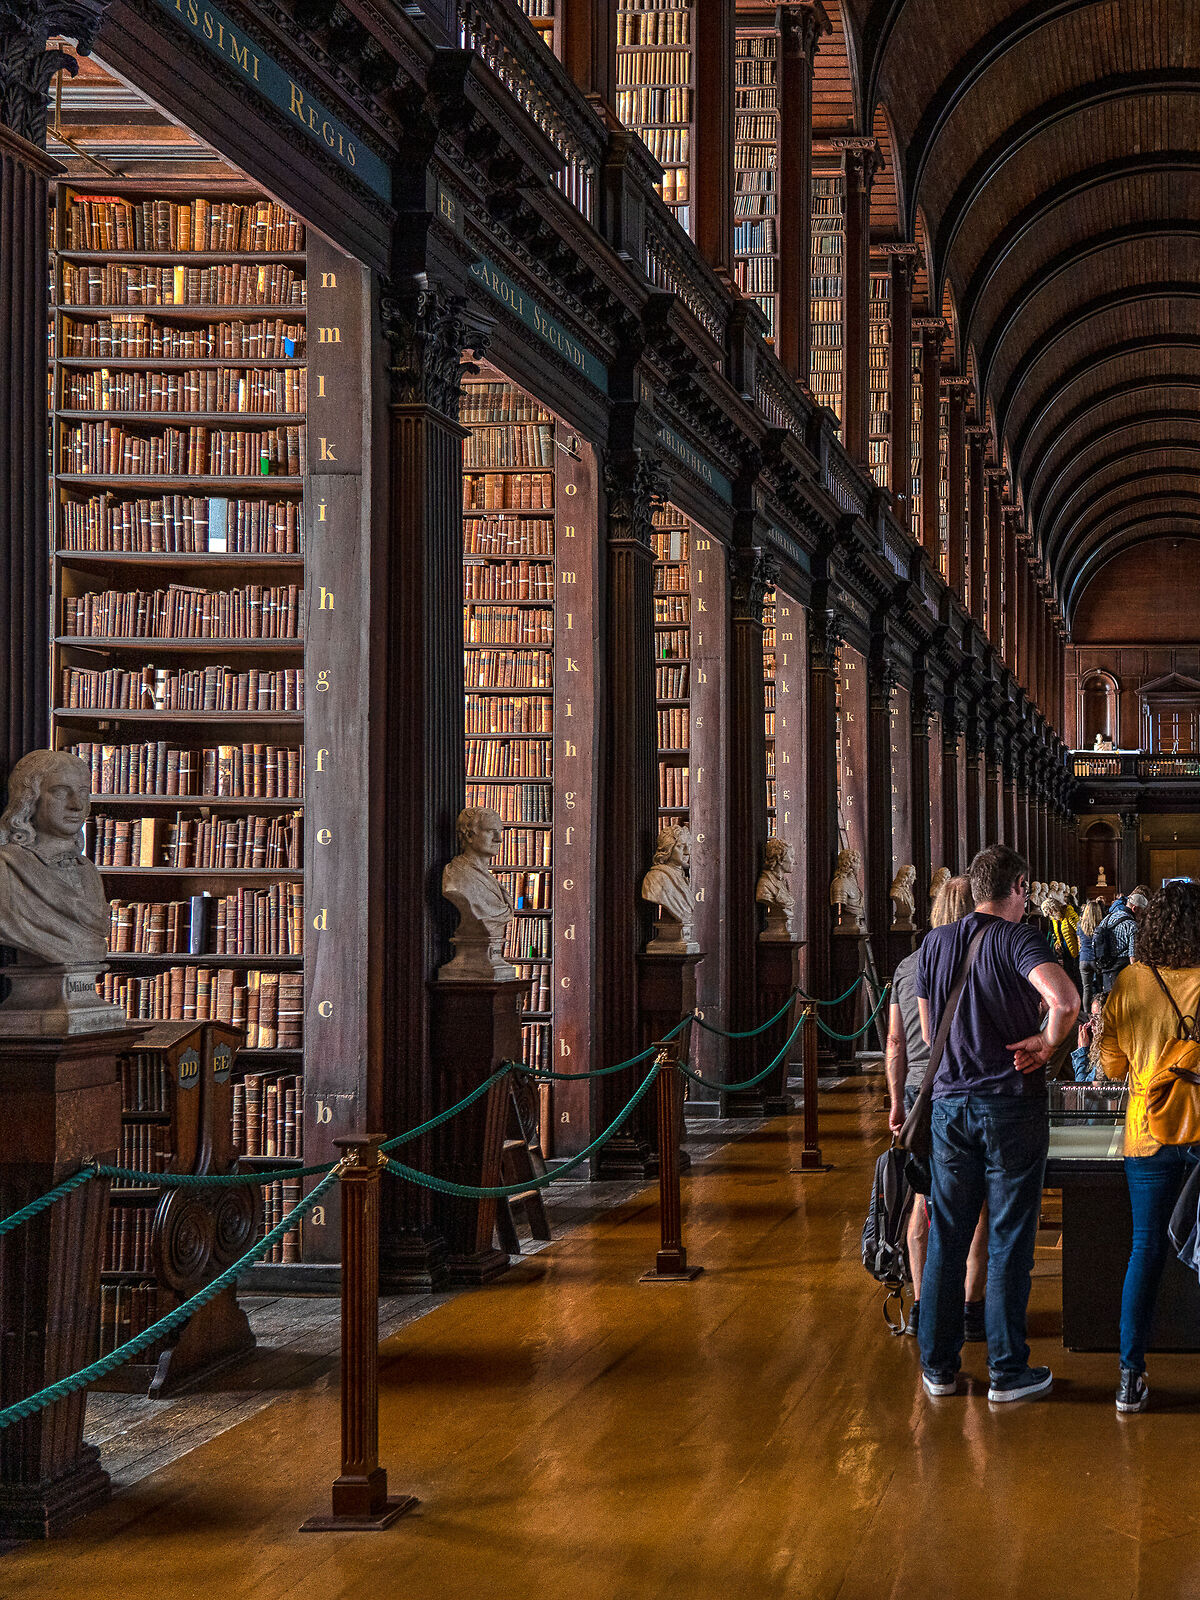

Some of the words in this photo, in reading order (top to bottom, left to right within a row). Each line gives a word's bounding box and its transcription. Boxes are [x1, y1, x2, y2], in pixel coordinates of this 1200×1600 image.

[289, 80, 355, 166] REGIS
[320, 272, 337, 288] n
[317, 326, 342, 343] m
[317, 375, 326, 397] l
[318, 437, 338, 460] k
[565, 483, 577, 496] o
[318, 497, 327, 521] i
[565, 526, 575, 538] n
[696, 539, 710, 551] m
[561, 572, 576, 584] m
[318, 587, 335, 610] h
[698, 598, 707, 612] k
[782, 607, 790, 616] n
[566, 613, 573, 629] l
[782, 632, 793, 641] m
[566, 657, 579, 671] k
[316, 669, 331, 691] g
[698, 669, 707, 683] h
[782, 680, 789, 693] k
[565, 698, 573, 716] i
[696, 716, 704, 728] g
[846, 712, 854, 722] k
[564, 740, 576, 757] h
[782, 751, 790, 763] h
[846, 766, 854, 776] h
[565, 791, 577, 810] g
[783, 790, 790, 801] g
[847, 796, 853, 806] g
[316, 828, 331, 845] e
[697, 833, 705, 843] e
[563, 879, 574, 890] e
[696, 888, 705, 902] d
[313, 908, 328, 931] d
[564, 924, 575, 940] d
[69, 981, 96, 992] Milton
[560, 976, 570, 988] c
[318, 1001, 333, 1018] c
[559, 1039, 571, 1057] b
[181, 1061, 198, 1078] DD
[213, 1055, 229, 1073] EE
[316, 1101, 332, 1124] b
[561, 1112, 570, 1123] a
[311, 1206, 326, 1226] a
